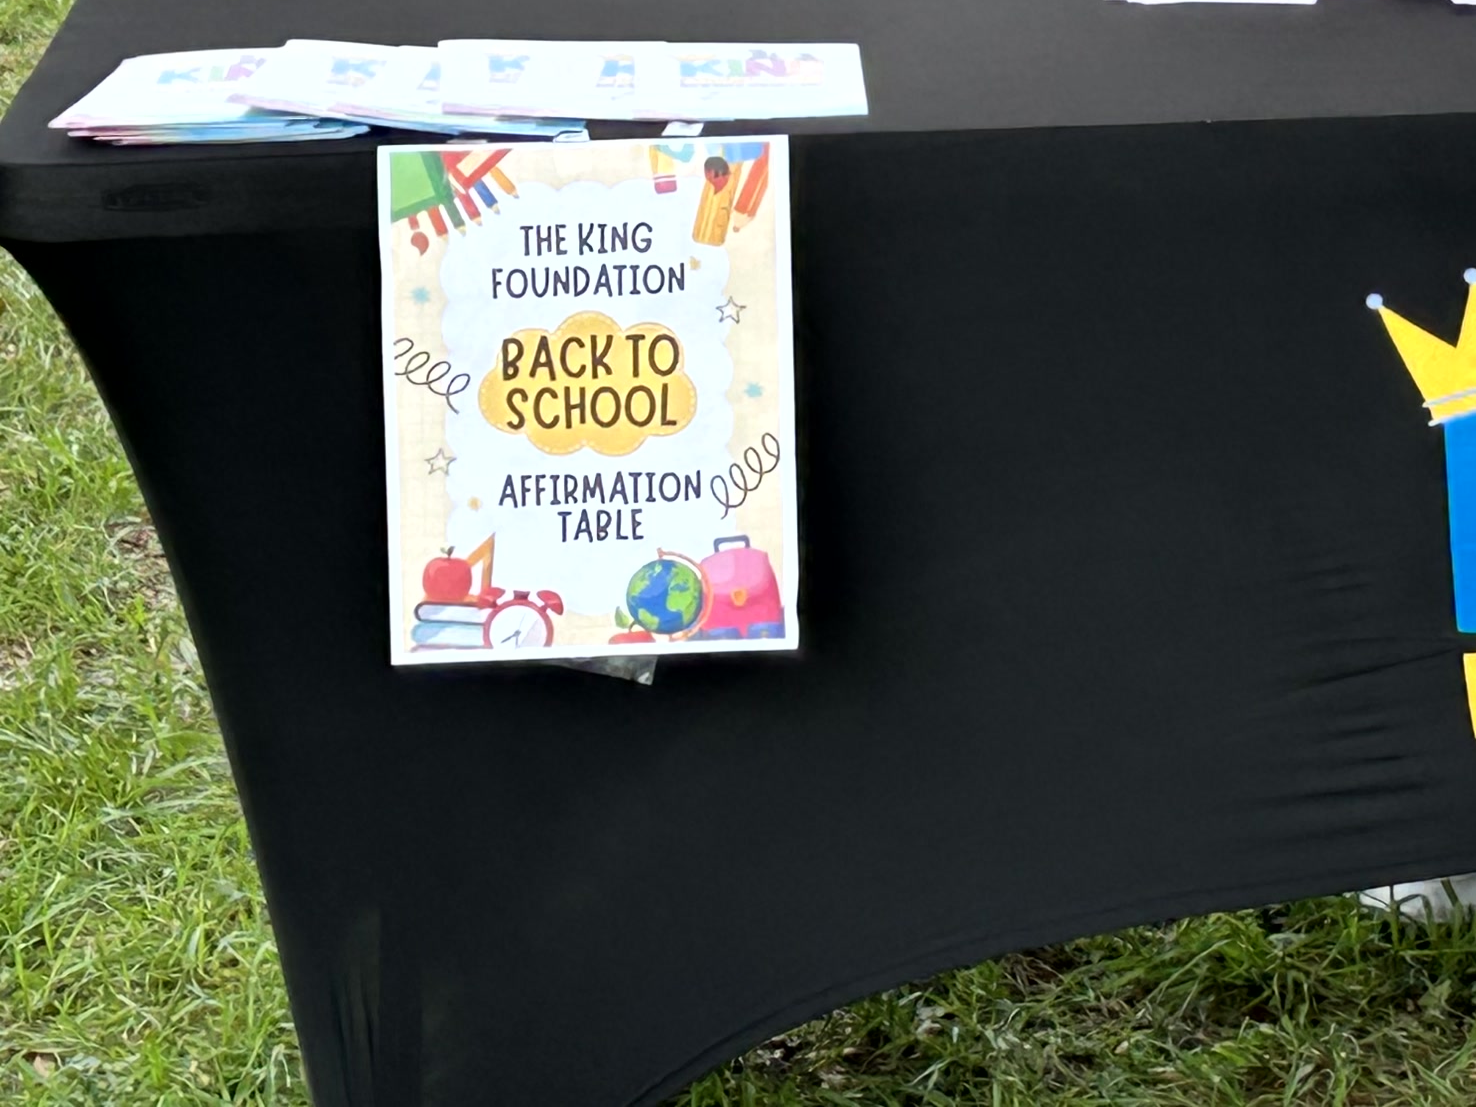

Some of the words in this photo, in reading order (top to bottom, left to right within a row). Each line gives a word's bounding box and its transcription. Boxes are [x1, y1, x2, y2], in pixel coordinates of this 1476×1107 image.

[520, 224, 567, 256] THE
[578, 221, 653, 254] KING
[491, 262, 686, 299] FOUNDATION
[501, 334, 614, 381] BACK
[625, 334, 680, 377] TO
[506, 383, 677, 430] SCHOOL
[498, 470, 701, 508] AFFIRMATION
[557, 507, 644, 542] TABLE
